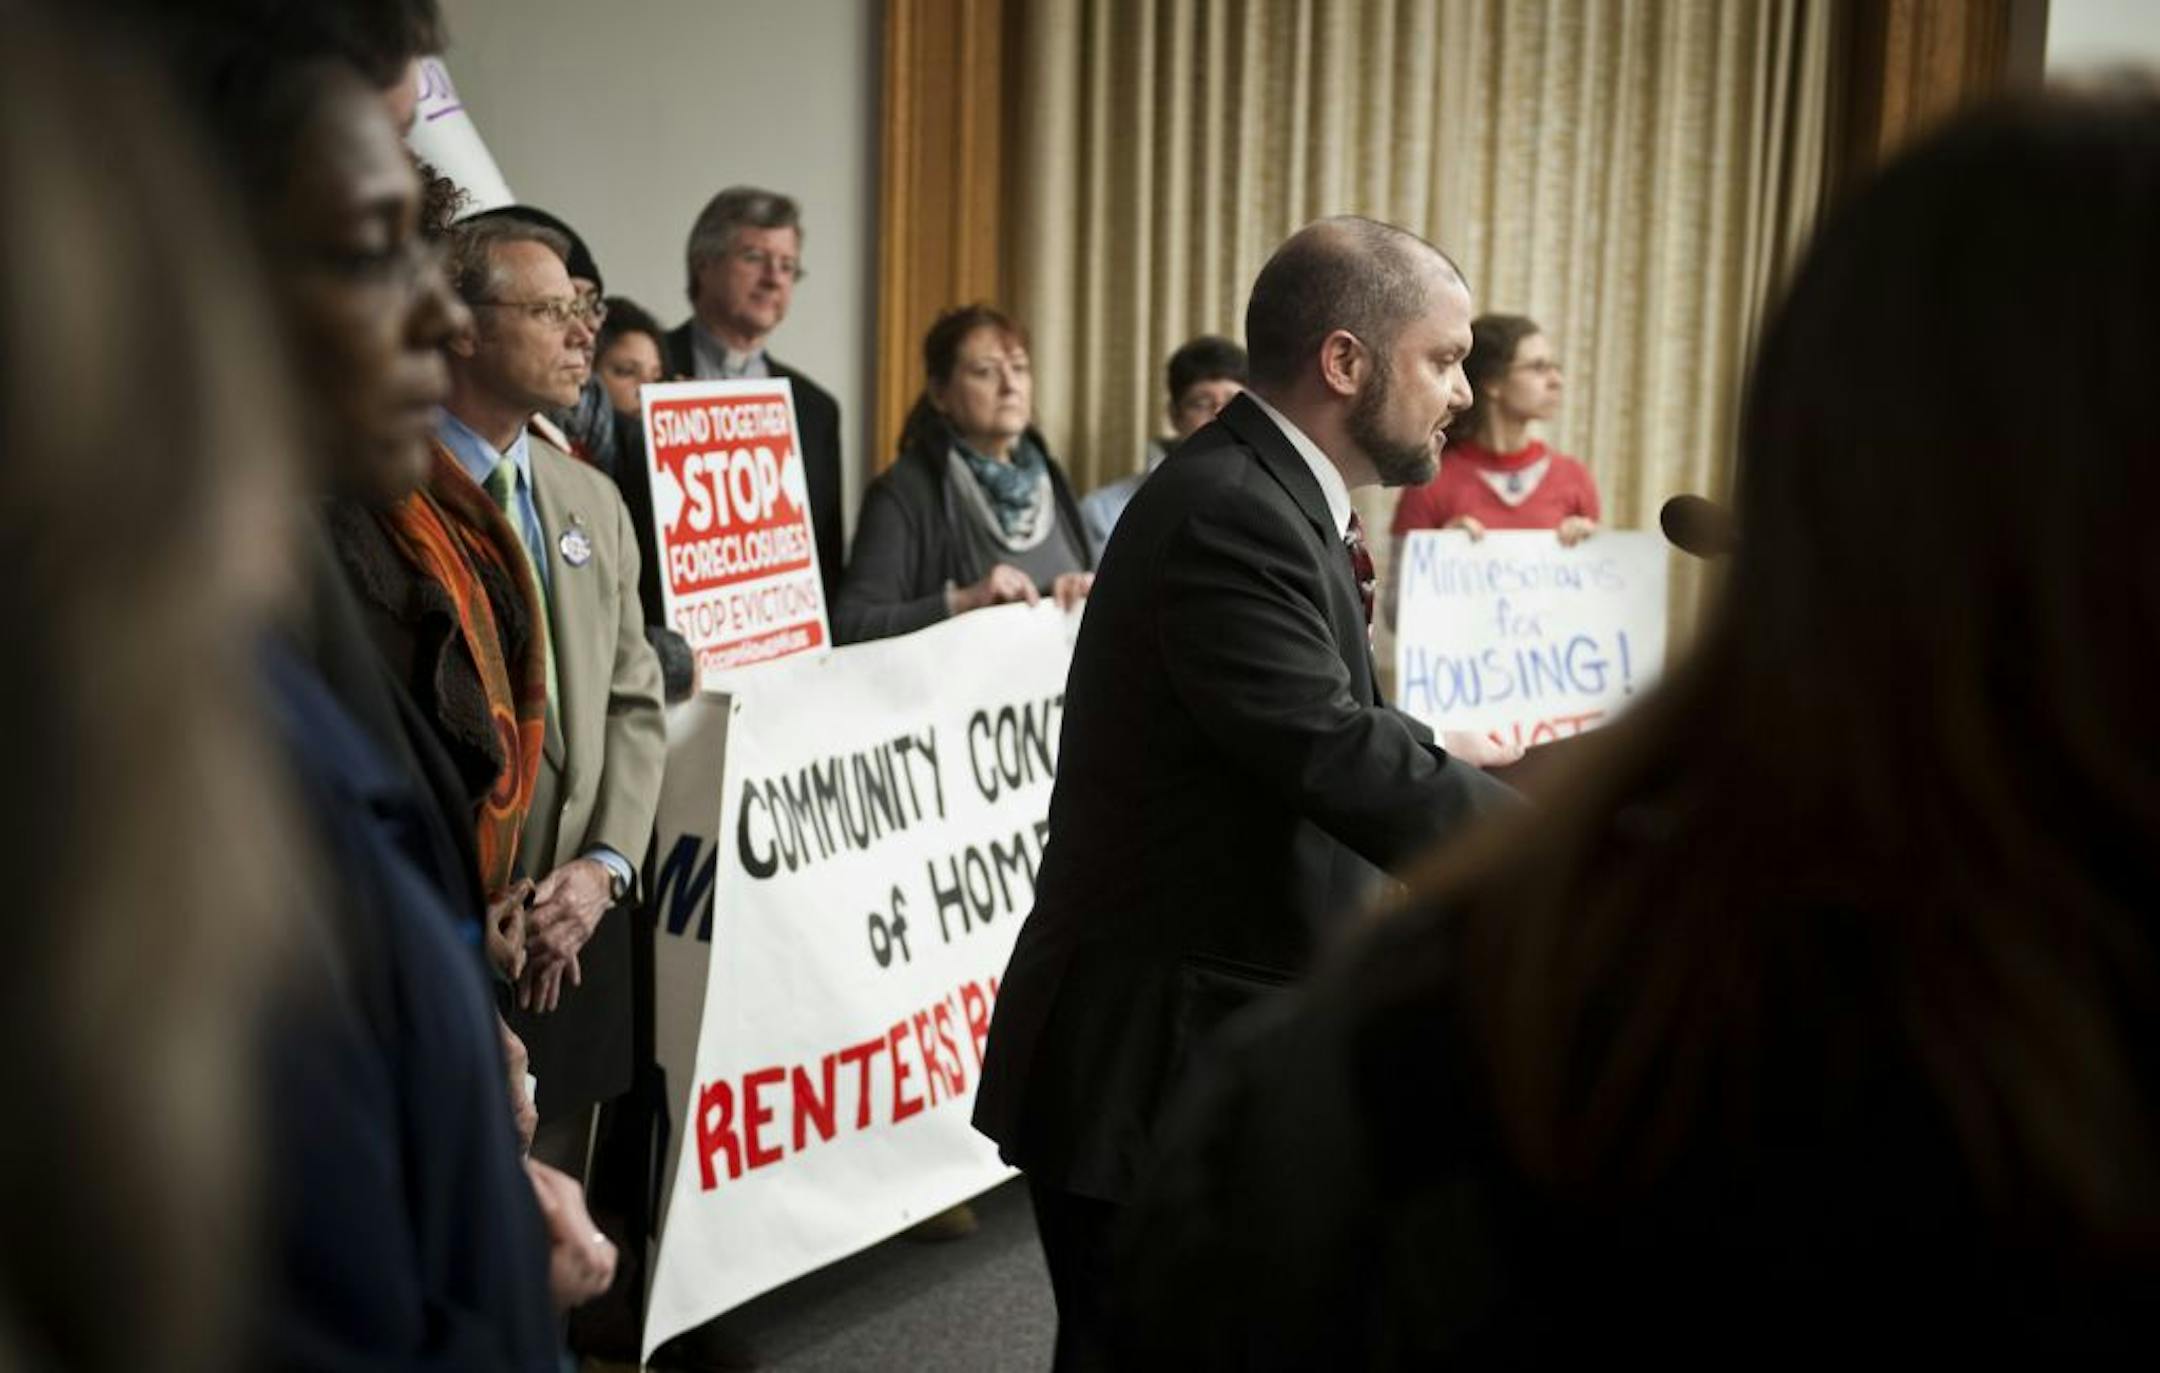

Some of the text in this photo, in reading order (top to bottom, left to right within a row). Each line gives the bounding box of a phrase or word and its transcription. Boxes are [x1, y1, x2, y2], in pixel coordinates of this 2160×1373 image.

[653, 402, 787, 448] STAND TOGETHER
[682, 446, 780, 532] STOP
[670, 523, 808, 586] FORECLOSURES
[674, 577, 819, 643] STOP EVICTIONS
[1403, 630, 1632, 712] HOUSING!
[737, 725, 945, 879] COMMUNITY
[868, 885, 910, 968] of
[696, 994, 966, 1191] RENTERS'
